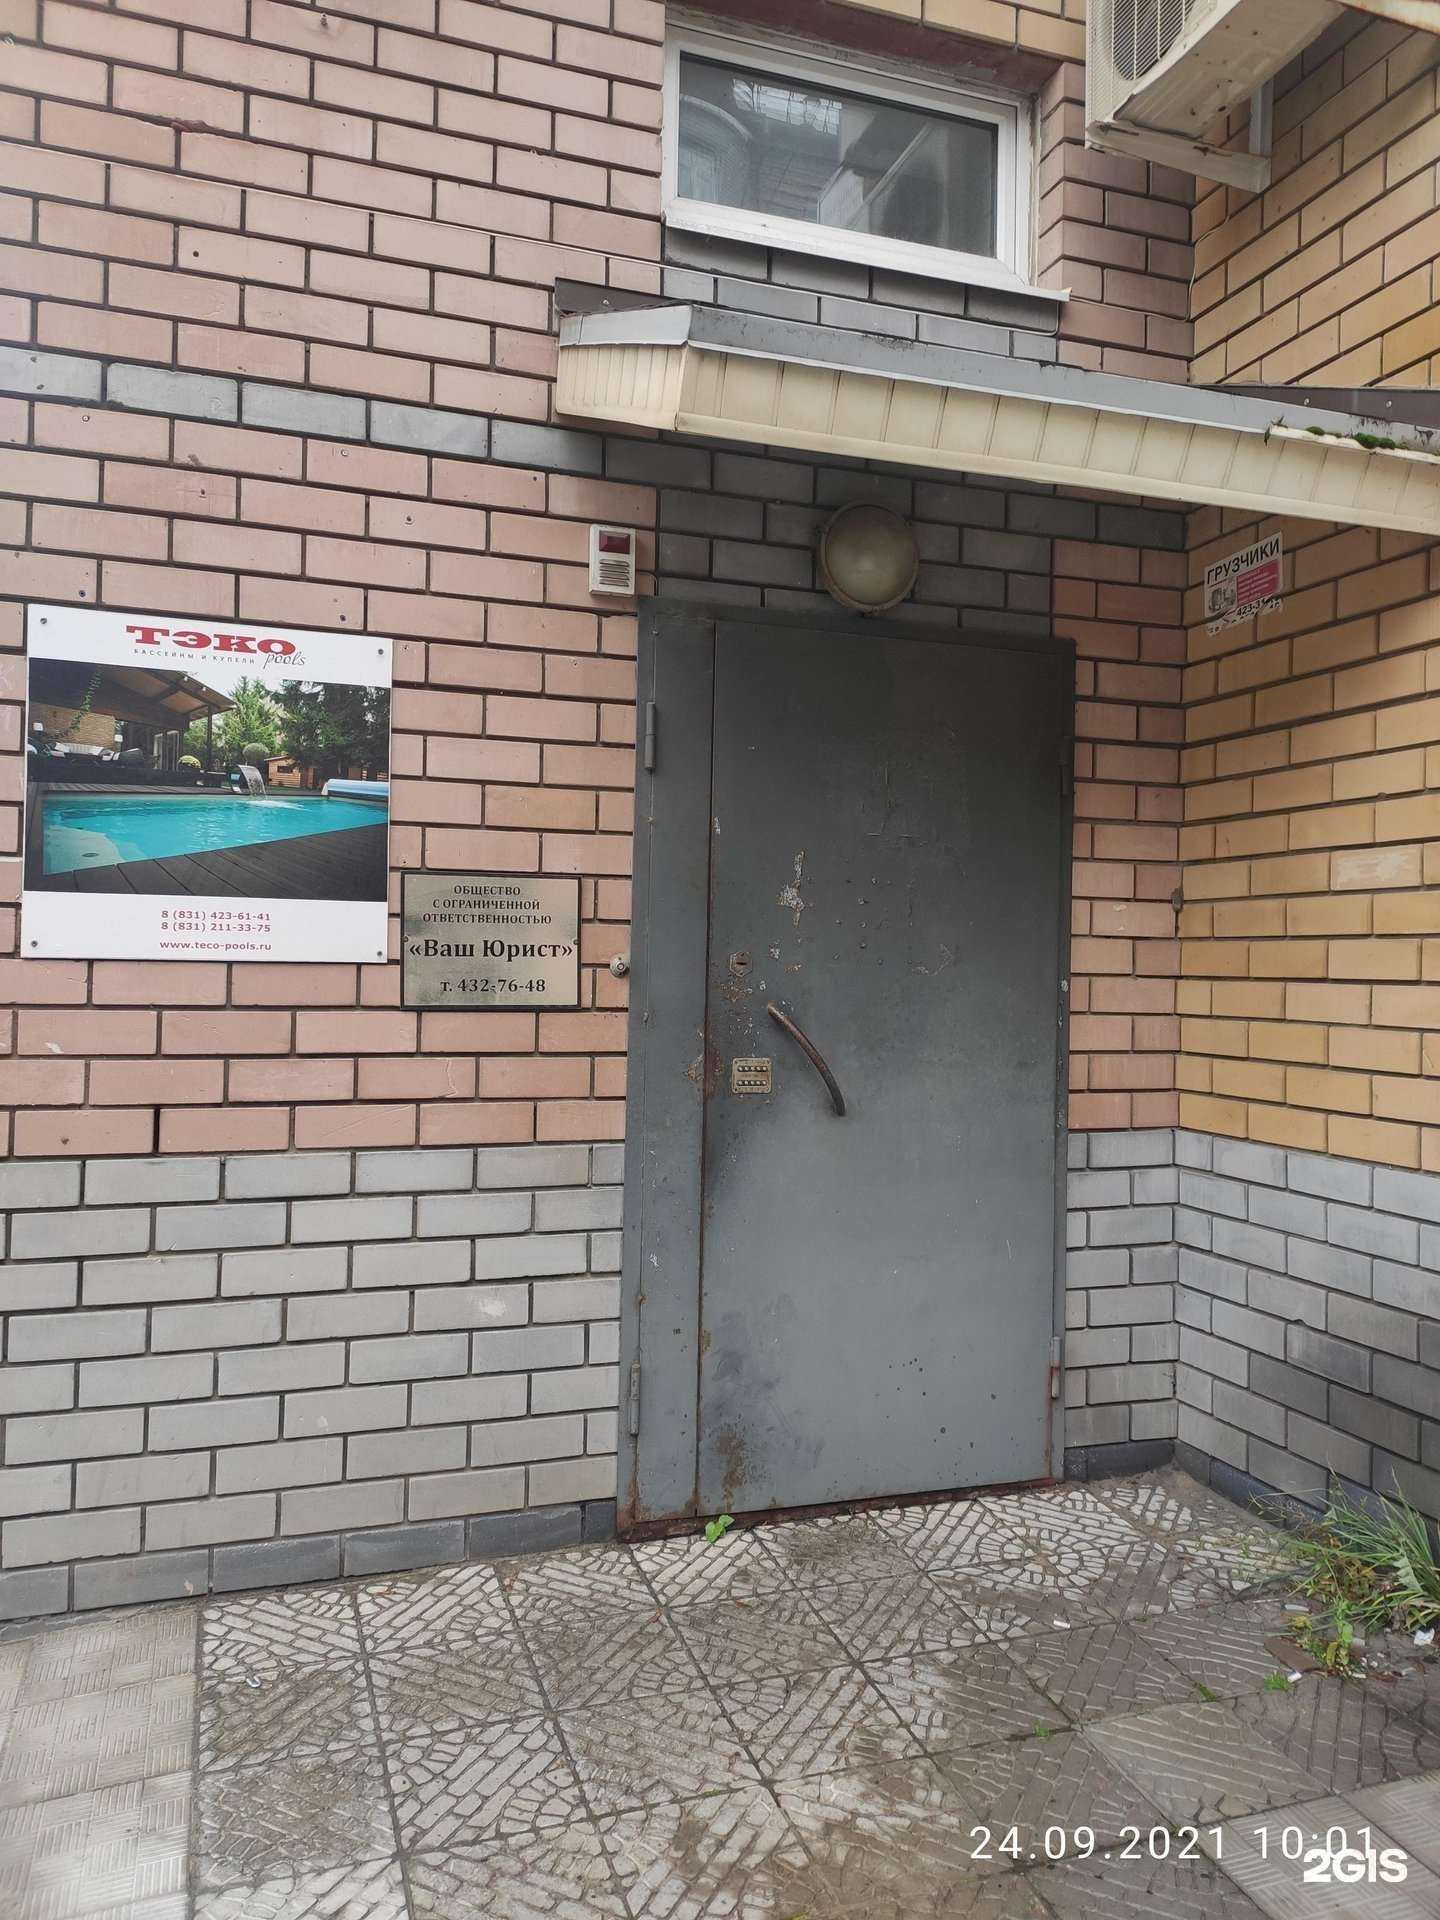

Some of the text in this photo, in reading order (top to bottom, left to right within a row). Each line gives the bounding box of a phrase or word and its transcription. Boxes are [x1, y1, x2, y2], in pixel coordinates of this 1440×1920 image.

[1207, 537, 1280, 585] ГРУЗЧИКИ
[126, 625, 296, 655] ТЭКО
[134, 648, 194, 659] БАССЕЙНЫ
[212, 655, 255, 665] КУПЕЛИ
[262, 651, 306, 669] pools
[453, 885, 521, 896] ОБЩЕСТВО
[432, 899, 540, 910] С ОГРАНИЧЕННОЙ
[161, 910, 271, 921] 8 (831) 423-61-41
[422, 913, 552, 924] ОТВЕТСТВЕННОСТЬЮ
[161, 921, 271, 932] 8 (831) 211-33-75
[159, 941, 272, 951] www.teco-pools.ru
[409, 939, 573, 962] «Ваш Юрист»
[440, 979, 546, 993] т. 432-76-48
